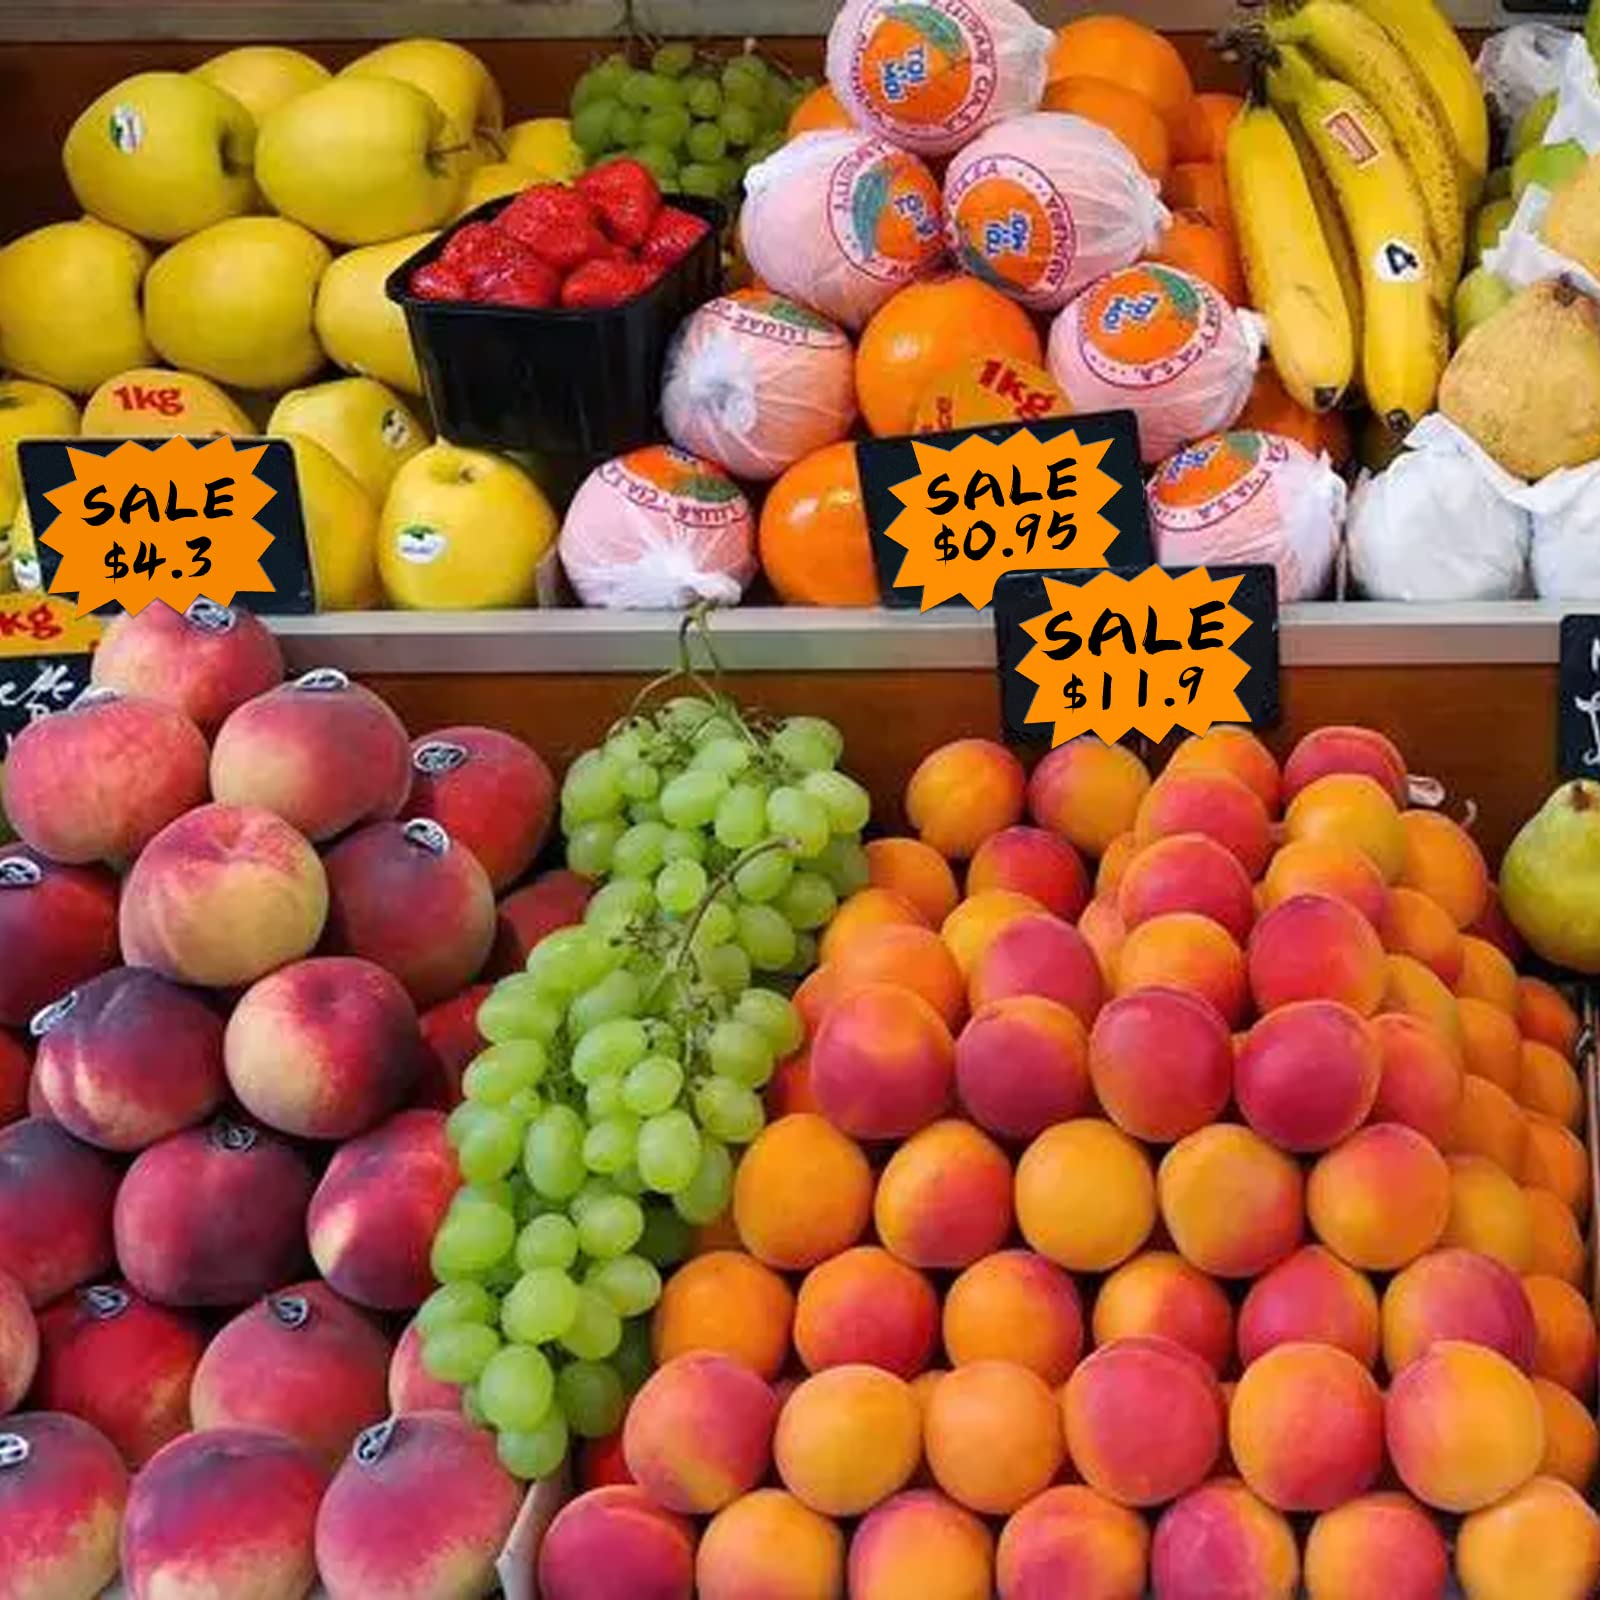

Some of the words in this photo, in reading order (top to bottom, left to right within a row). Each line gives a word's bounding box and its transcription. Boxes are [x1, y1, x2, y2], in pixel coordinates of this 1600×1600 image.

[1386, 243, 1418, 274] 4
[113, 385, 185, 417] 1kg
[81, 477, 236, 526] SALE
[925, 457, 1079, 516] SALE
[104, 536, 212, 584] $4.3
[934, 510, 1078, 567] $0.95
[1040, 600, 1226, 661] SALE
[1063, 666, 1205, 714] $11.9
